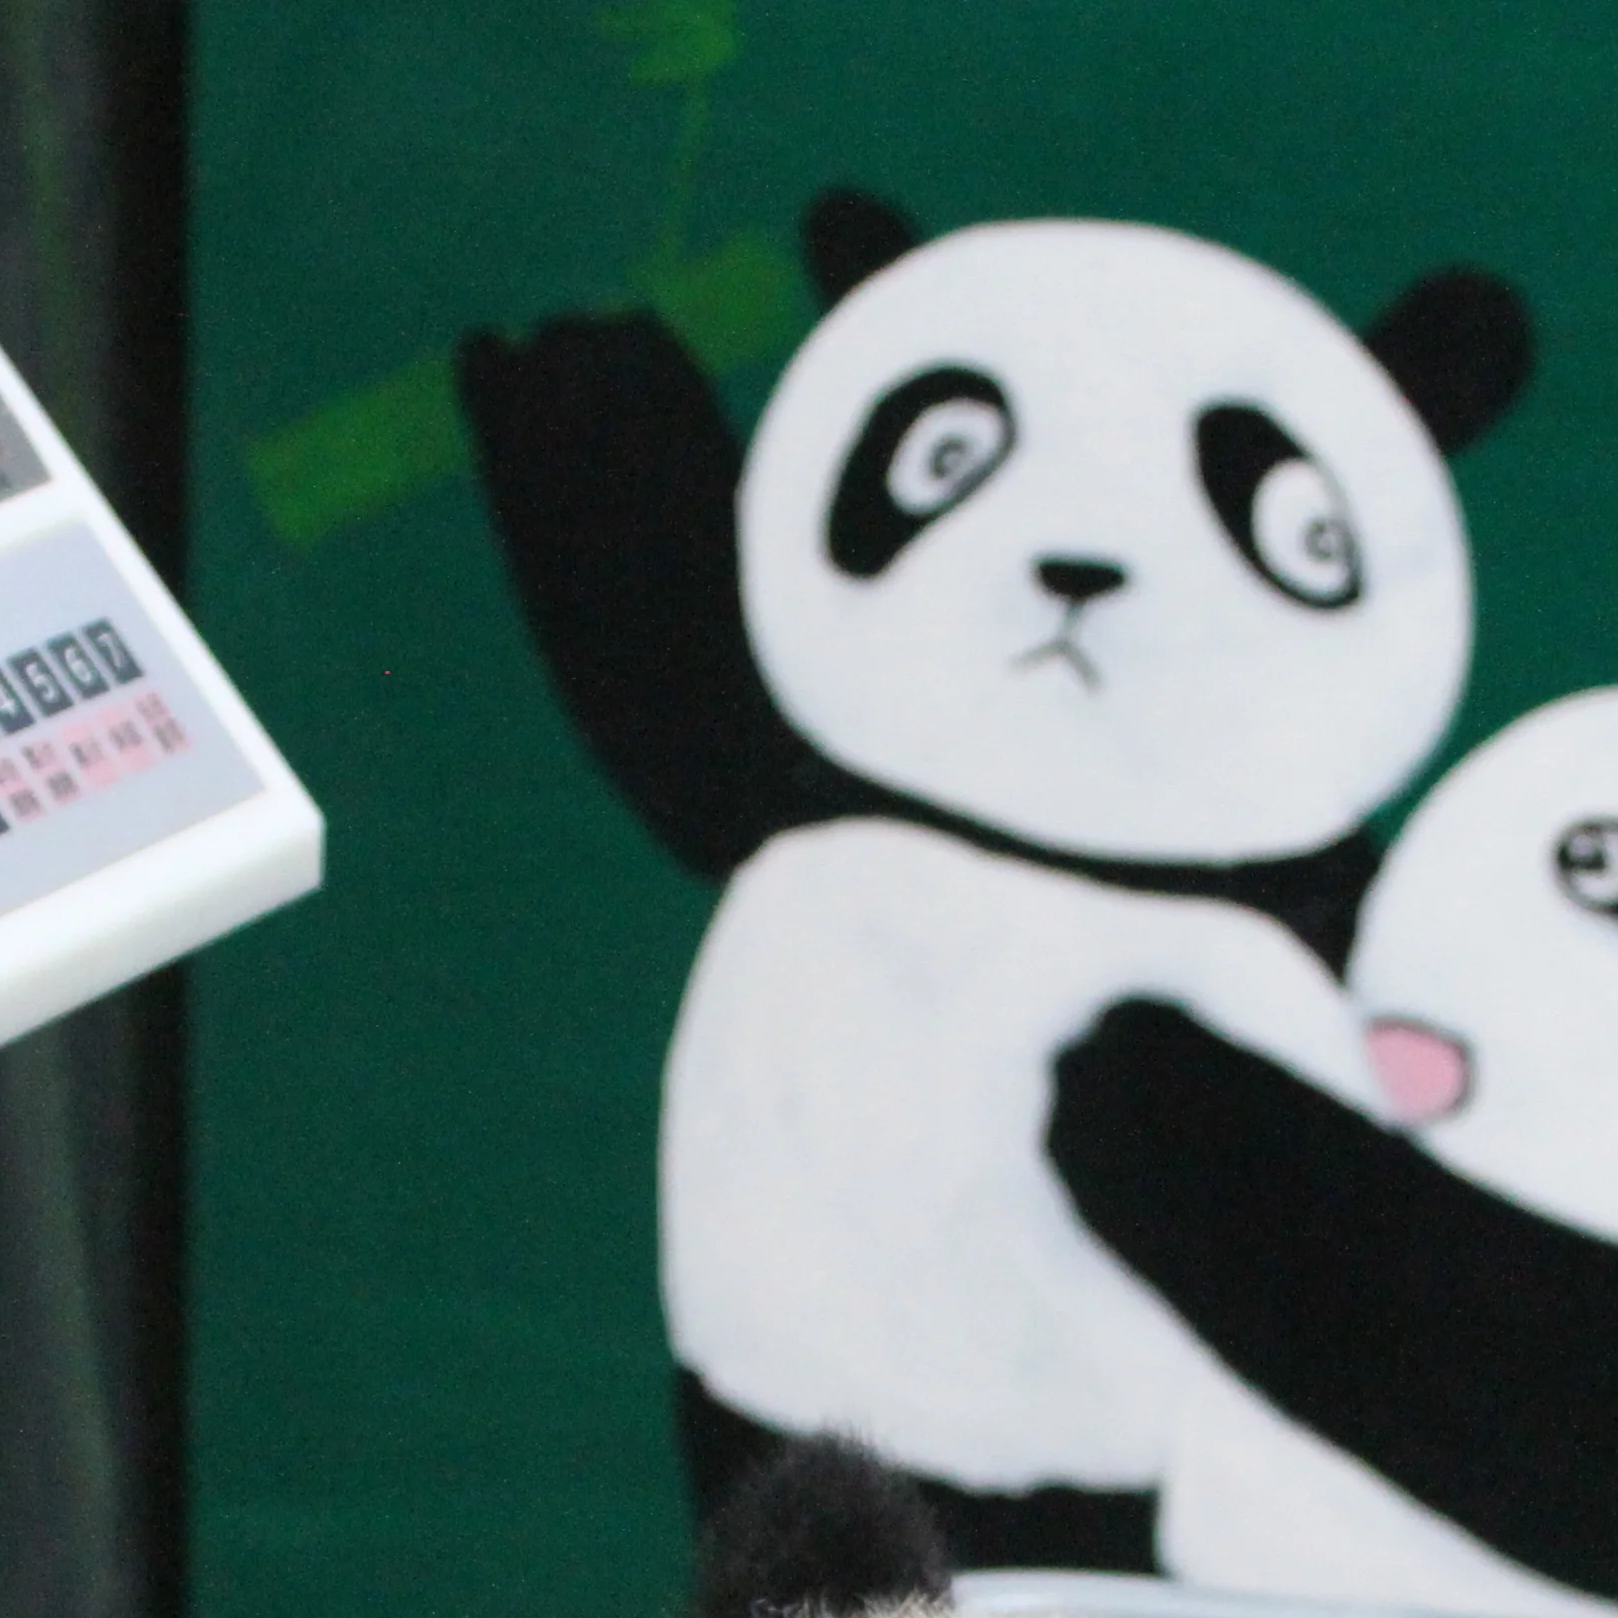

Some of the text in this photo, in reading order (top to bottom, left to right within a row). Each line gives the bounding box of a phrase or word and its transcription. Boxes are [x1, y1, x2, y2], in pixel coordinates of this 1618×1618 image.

[24, 661, 56, 700] 5
[64, 645, 93, 684] 6
[97, 632, 124, 671] 7
